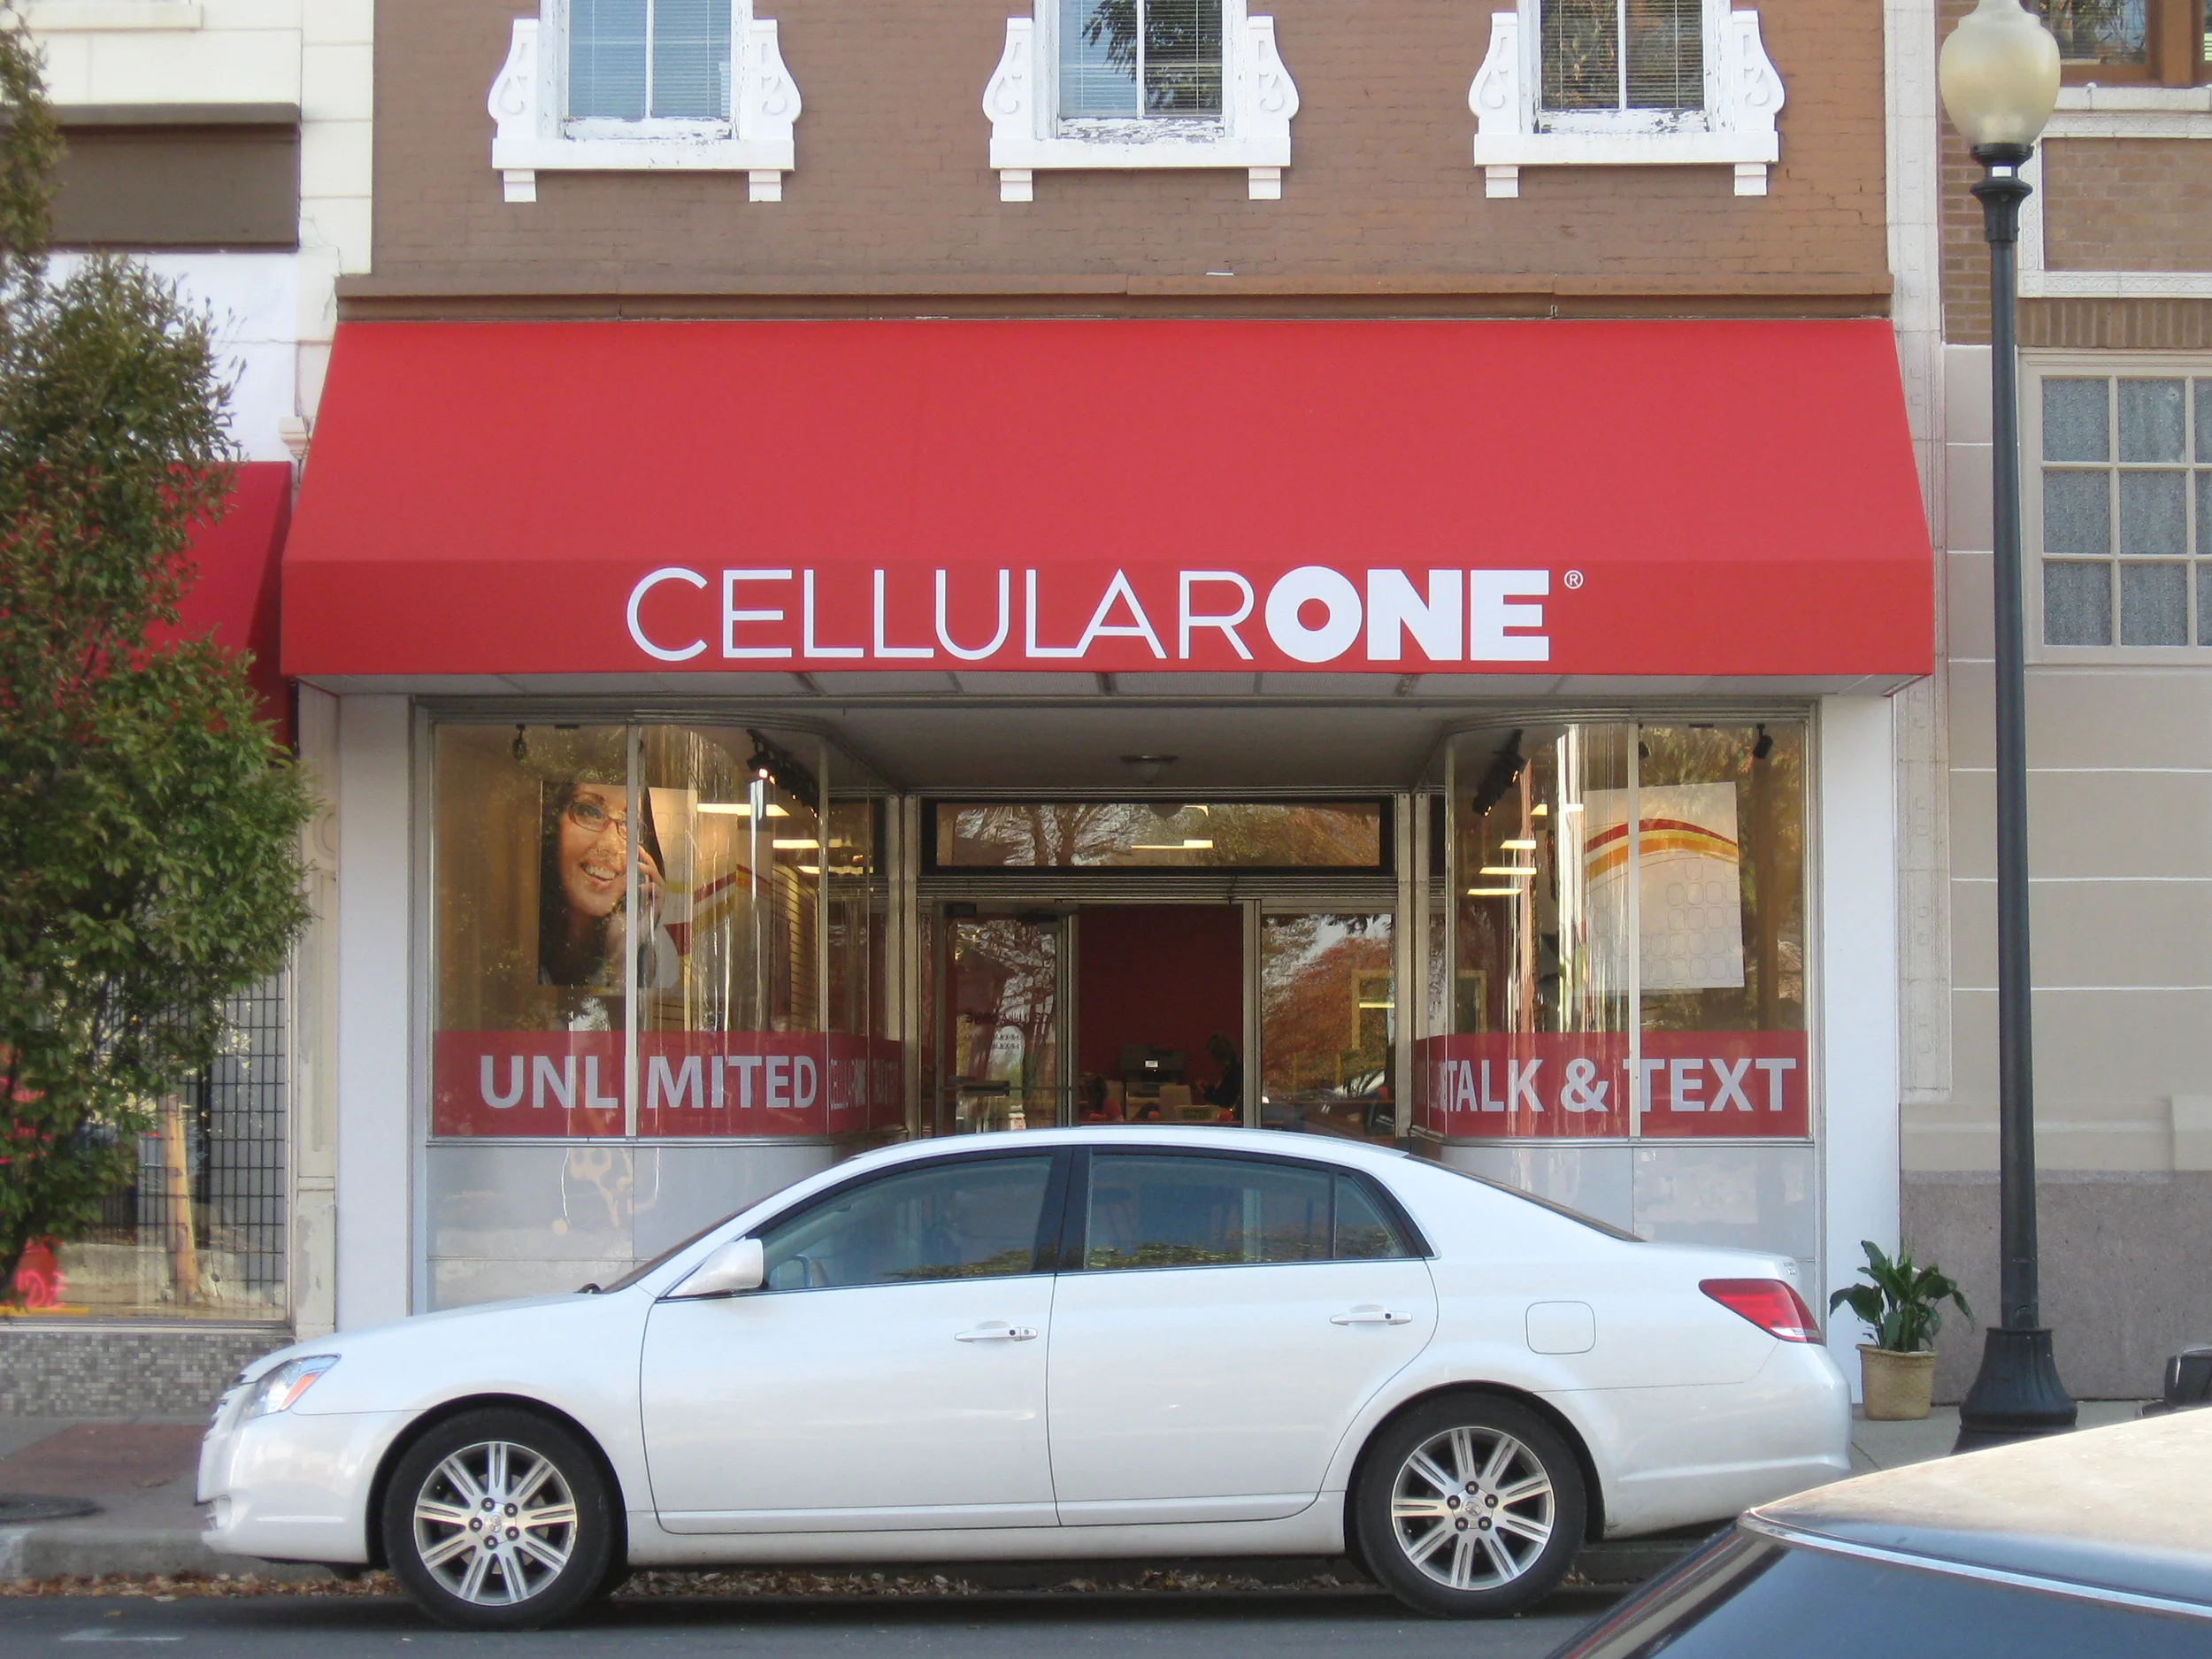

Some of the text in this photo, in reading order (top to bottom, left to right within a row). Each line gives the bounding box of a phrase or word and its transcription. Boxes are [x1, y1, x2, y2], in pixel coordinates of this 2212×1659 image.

[1447, 1058, 1545, 1113] TALK
[1560, 1057, 1609, 1113] &
[1623, 1057, 1797, 1112] TEXT
